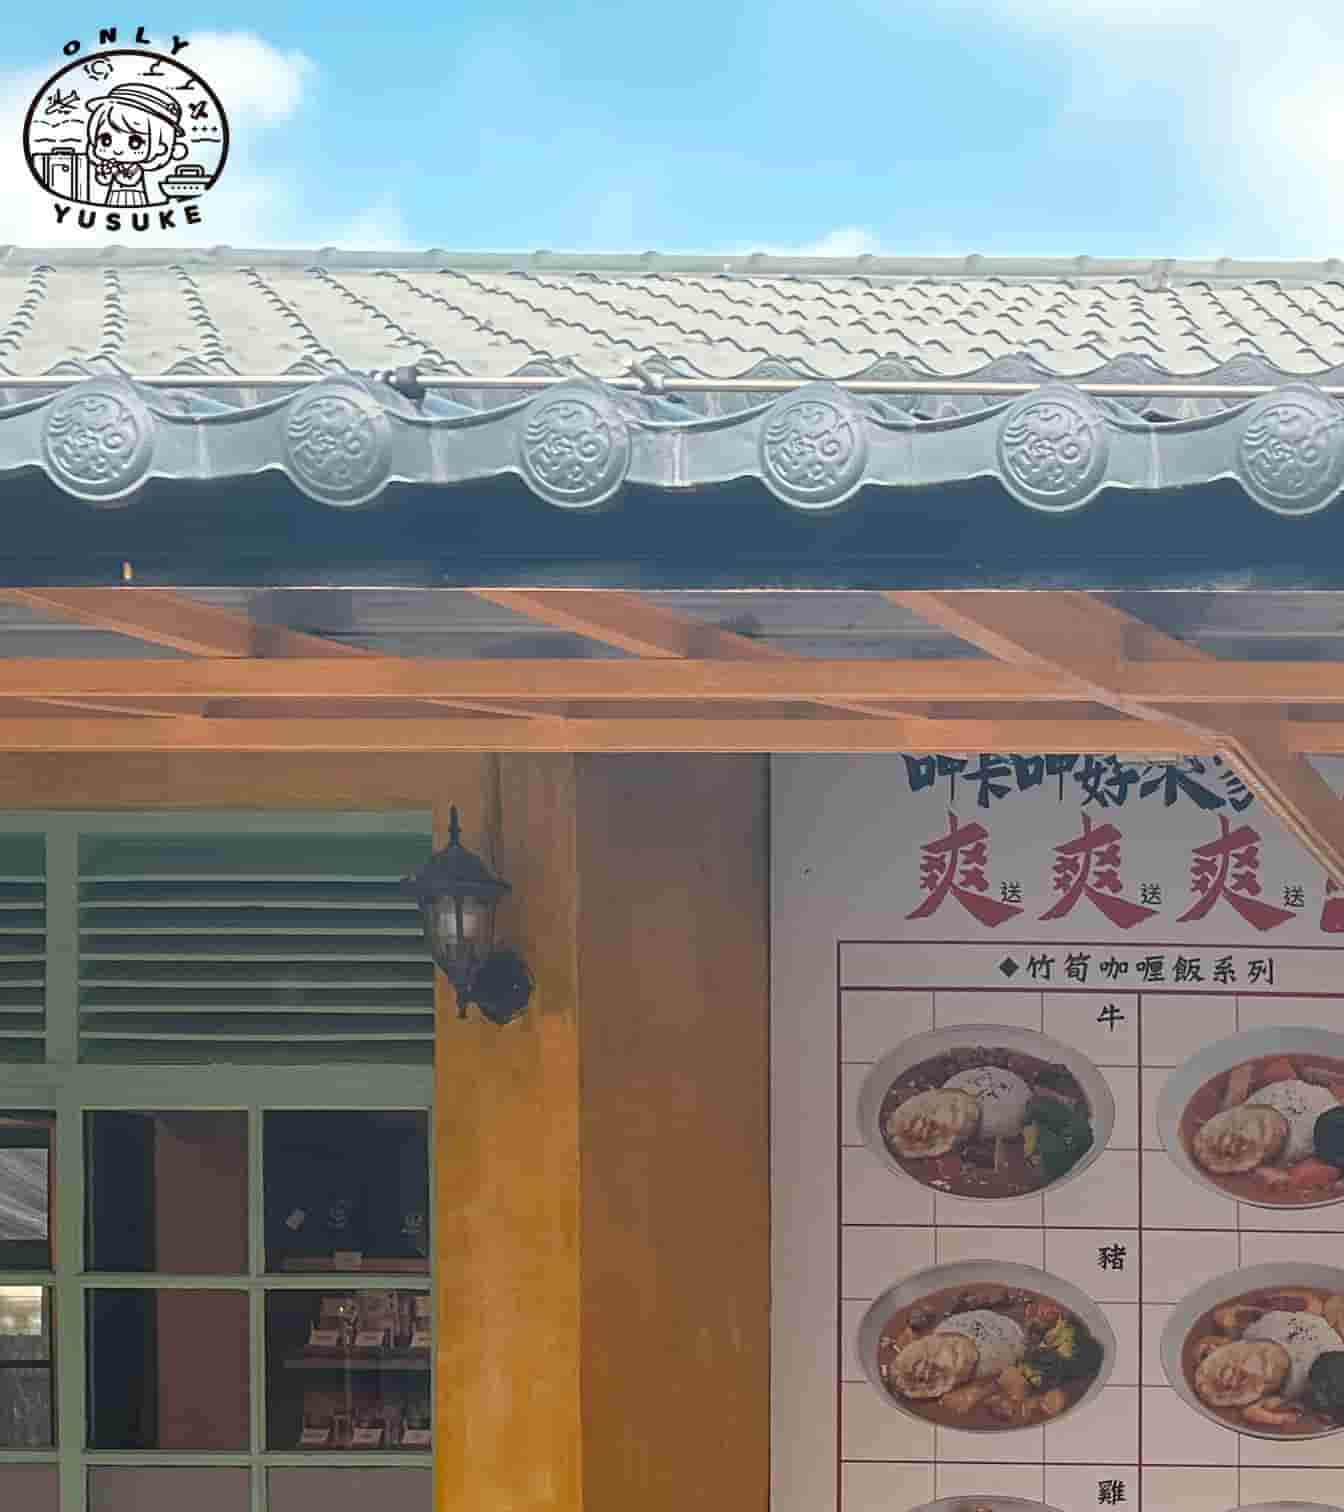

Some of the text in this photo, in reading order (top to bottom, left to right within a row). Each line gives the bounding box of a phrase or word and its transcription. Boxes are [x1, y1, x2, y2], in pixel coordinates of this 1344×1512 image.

[1097, 1004, 1126, 1031] 牛
[1097, 1243, 1127, 1273] 豬
[1097, 1480, 1127, 1506] 雞
